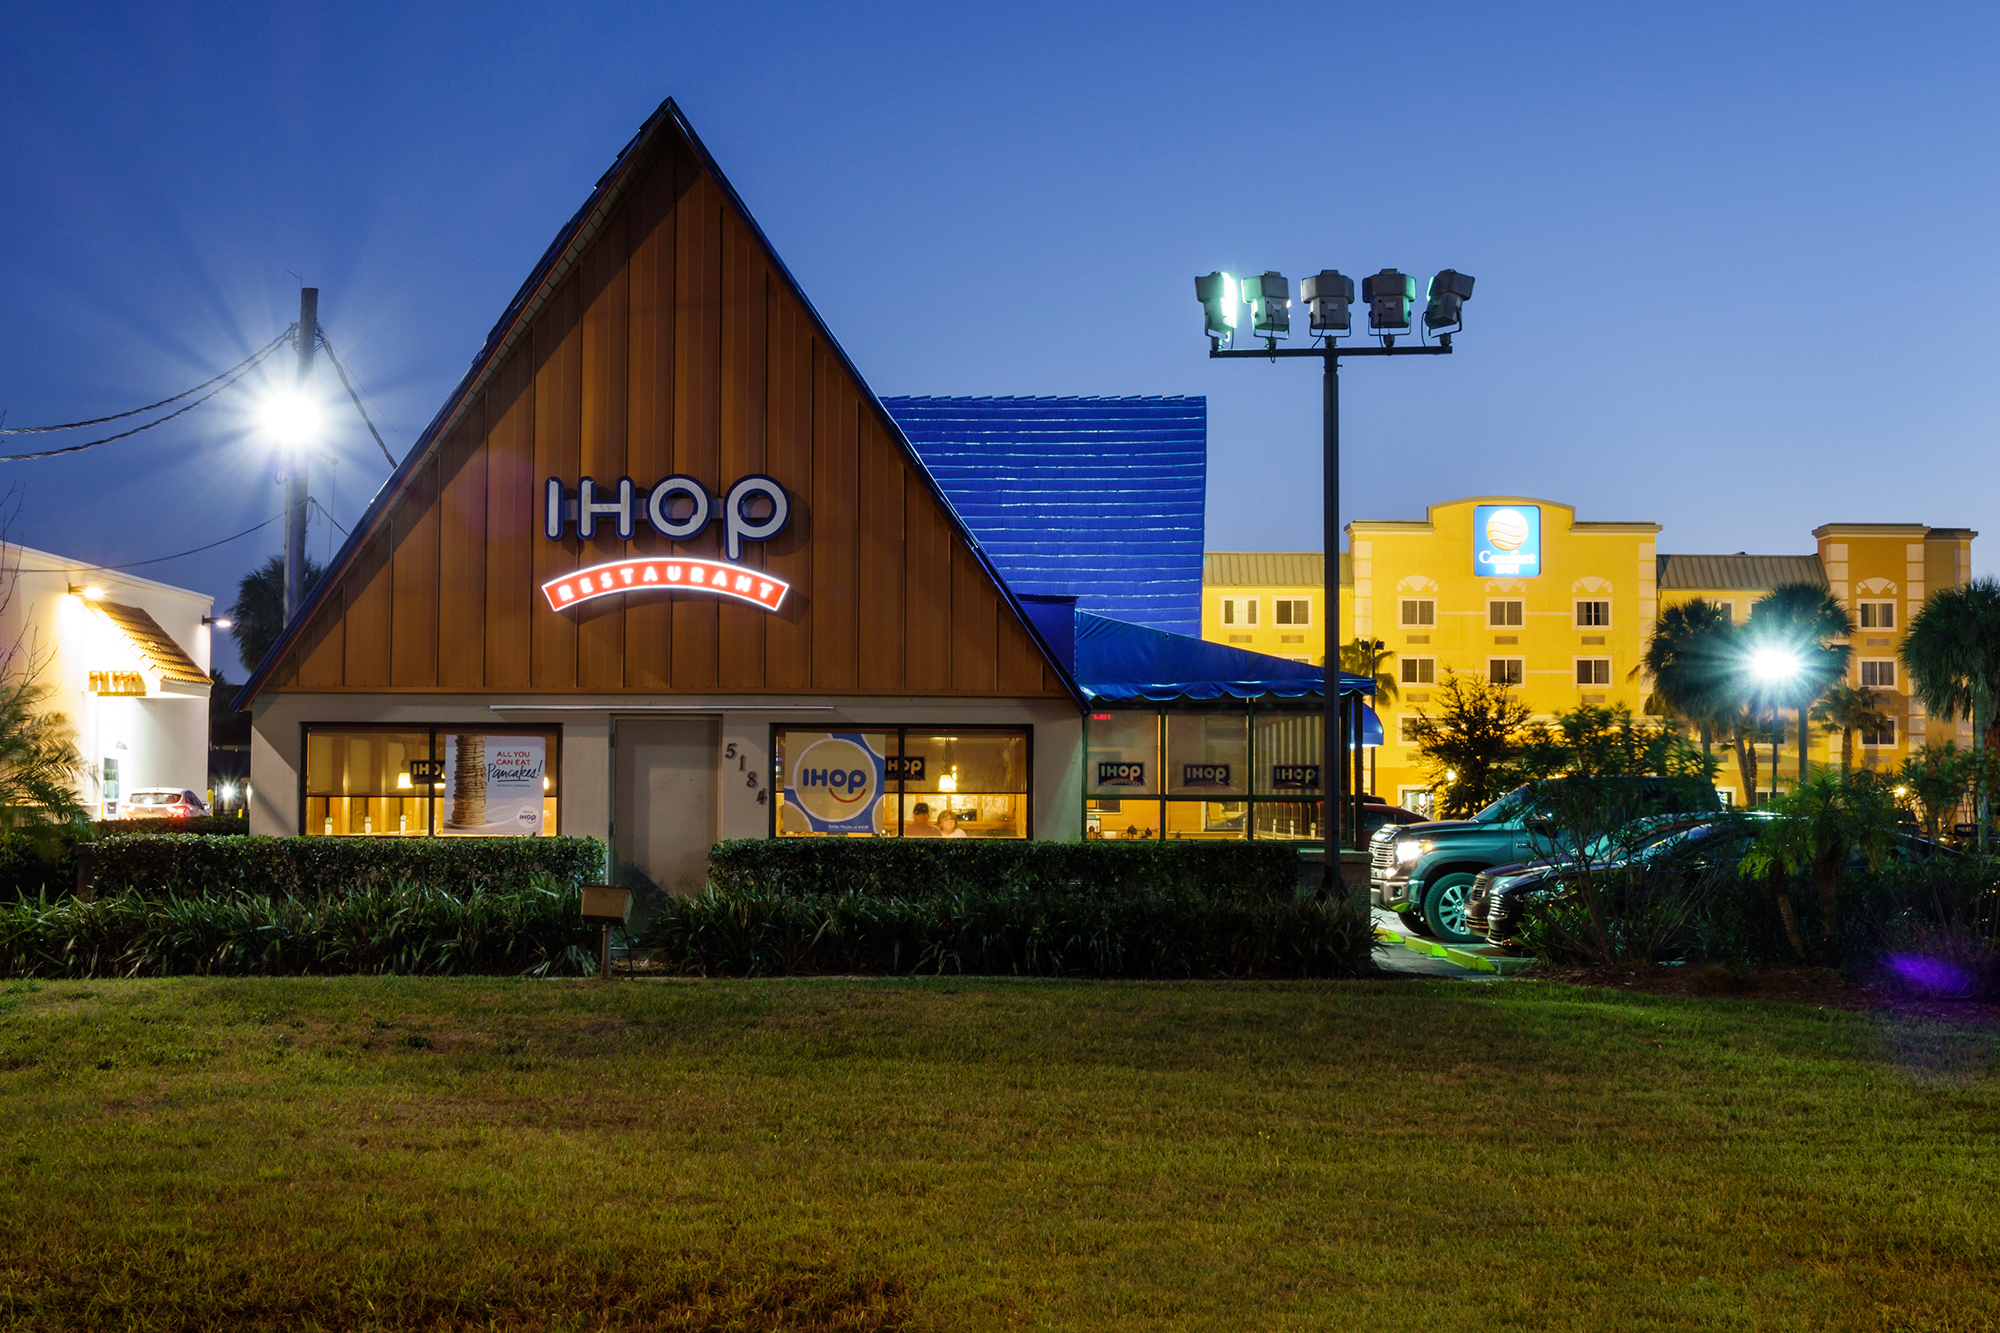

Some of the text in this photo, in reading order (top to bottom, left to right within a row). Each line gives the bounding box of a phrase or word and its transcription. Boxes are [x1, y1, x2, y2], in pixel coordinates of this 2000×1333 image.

[1494, 563, 1520, 575] INN
[557, 565, 774, 602] RESTAURANT
[88, 670, 140, 682] ENTER
[487, 759, 543, 782] Pancakes!
[725, 742, 768, 806] 5184
